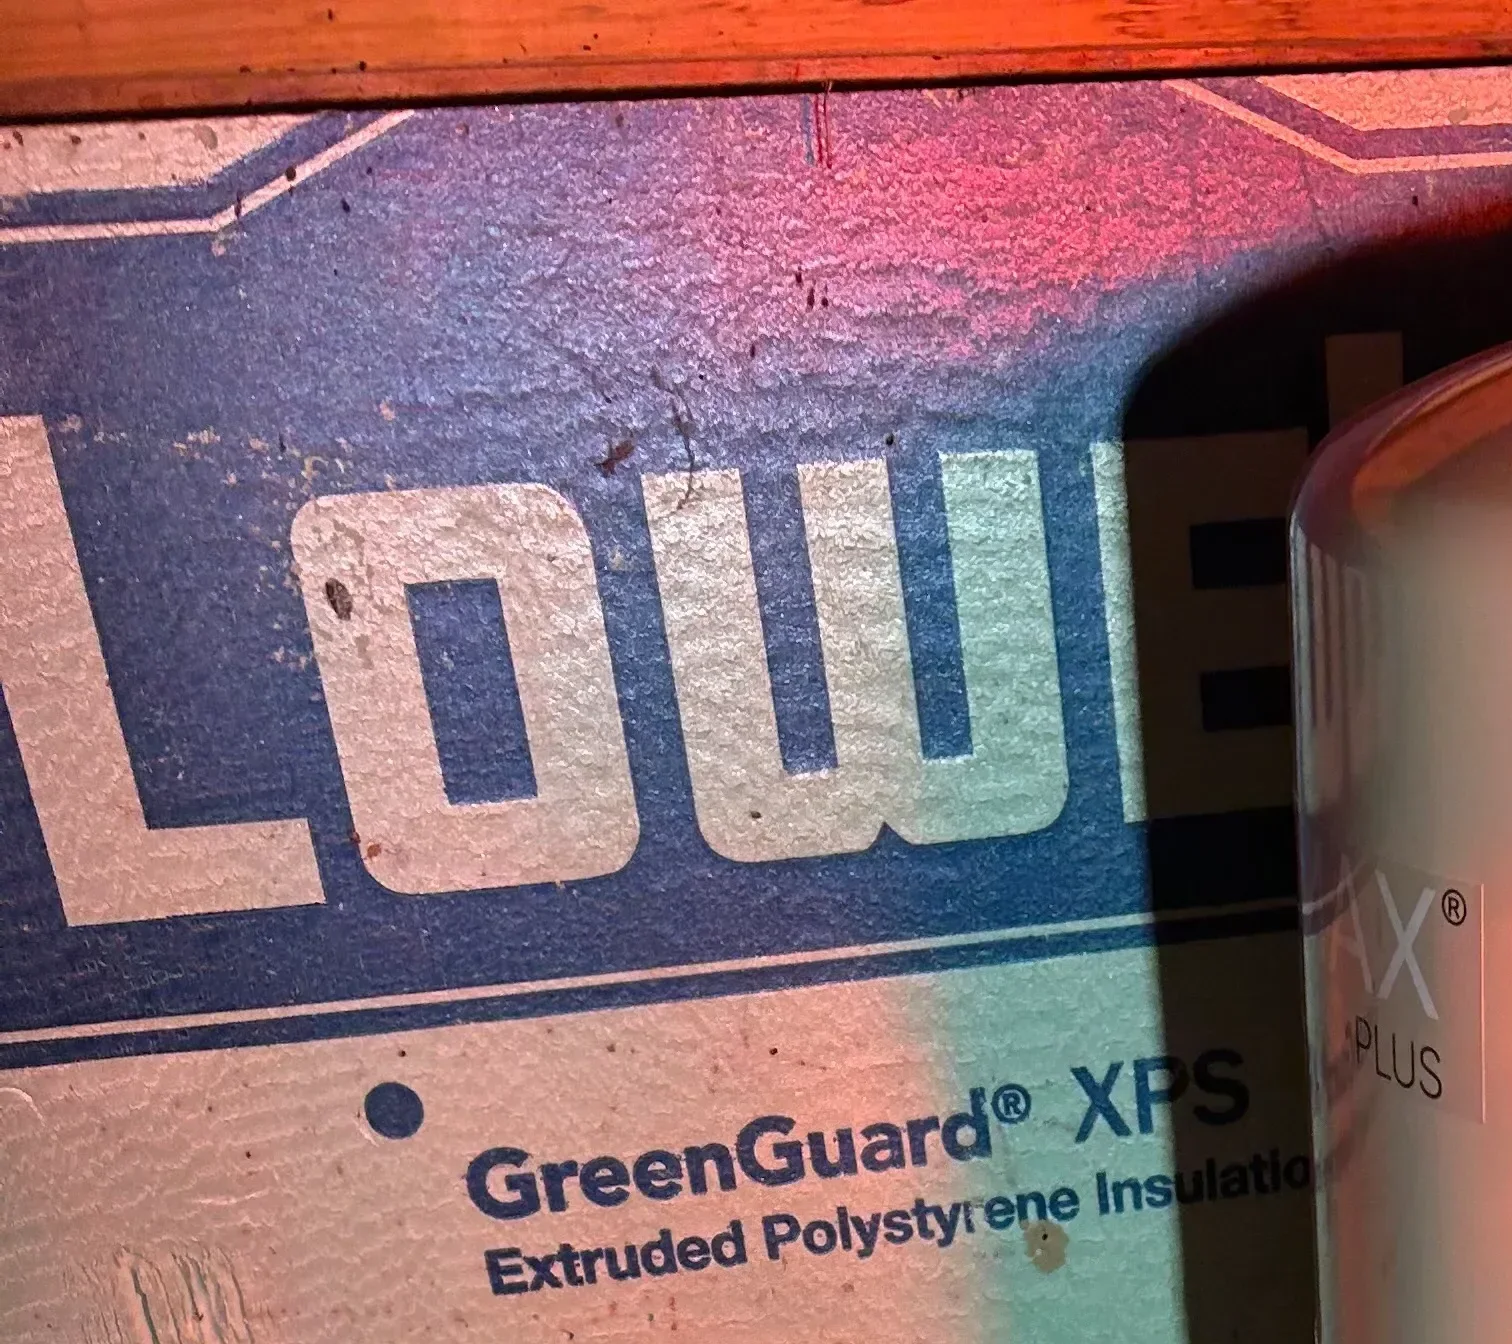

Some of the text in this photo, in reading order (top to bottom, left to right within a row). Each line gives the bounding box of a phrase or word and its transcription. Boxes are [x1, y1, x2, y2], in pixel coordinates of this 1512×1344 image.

[0, 412, 1308, 926] LOWE
[1070, 1046, 1251, 1145] XPS
[1355, 1013, 1444, 1100] PLUS
[483, 1148, 1312, 1297] Extruded Polystyrene Insulatio
